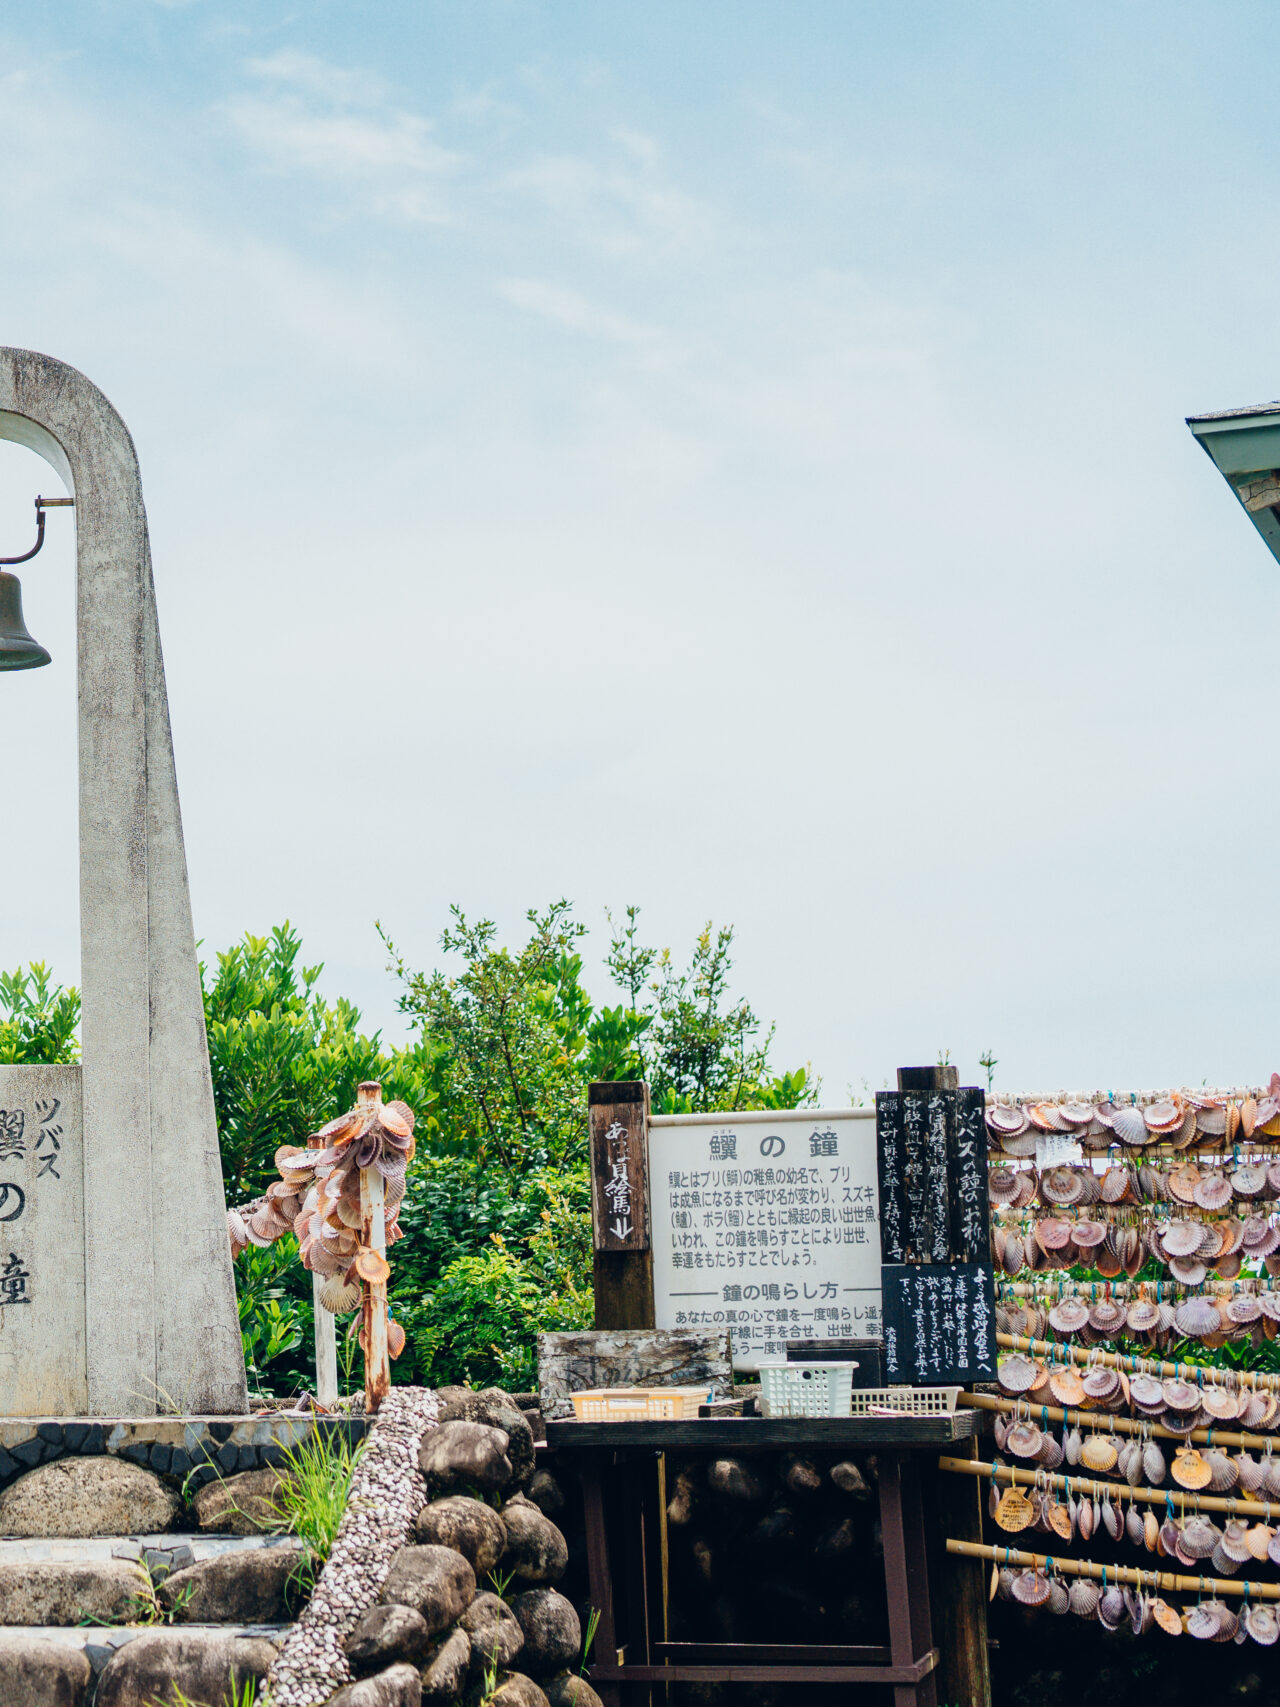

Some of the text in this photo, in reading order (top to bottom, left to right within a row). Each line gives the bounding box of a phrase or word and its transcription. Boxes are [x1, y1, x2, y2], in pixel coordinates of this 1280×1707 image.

[34, 1098, 63, 1179] ツバス
[670, 1186, 875, 1208] は成魚になるまで呼び名が変わり、スズキ
[671, 1206, 880, 1228] (鱸)、ボラ(鯔)とともに縁起の良い出世魚
[672, 1226, 870, 1248] いわれ、この鐘を鳴らすことにより出世、
[672, 1248, 816, 1269] 幸運をもたらすことでしょう。
[722, 1282, 839, 1302] 鐘の鳴らし方
